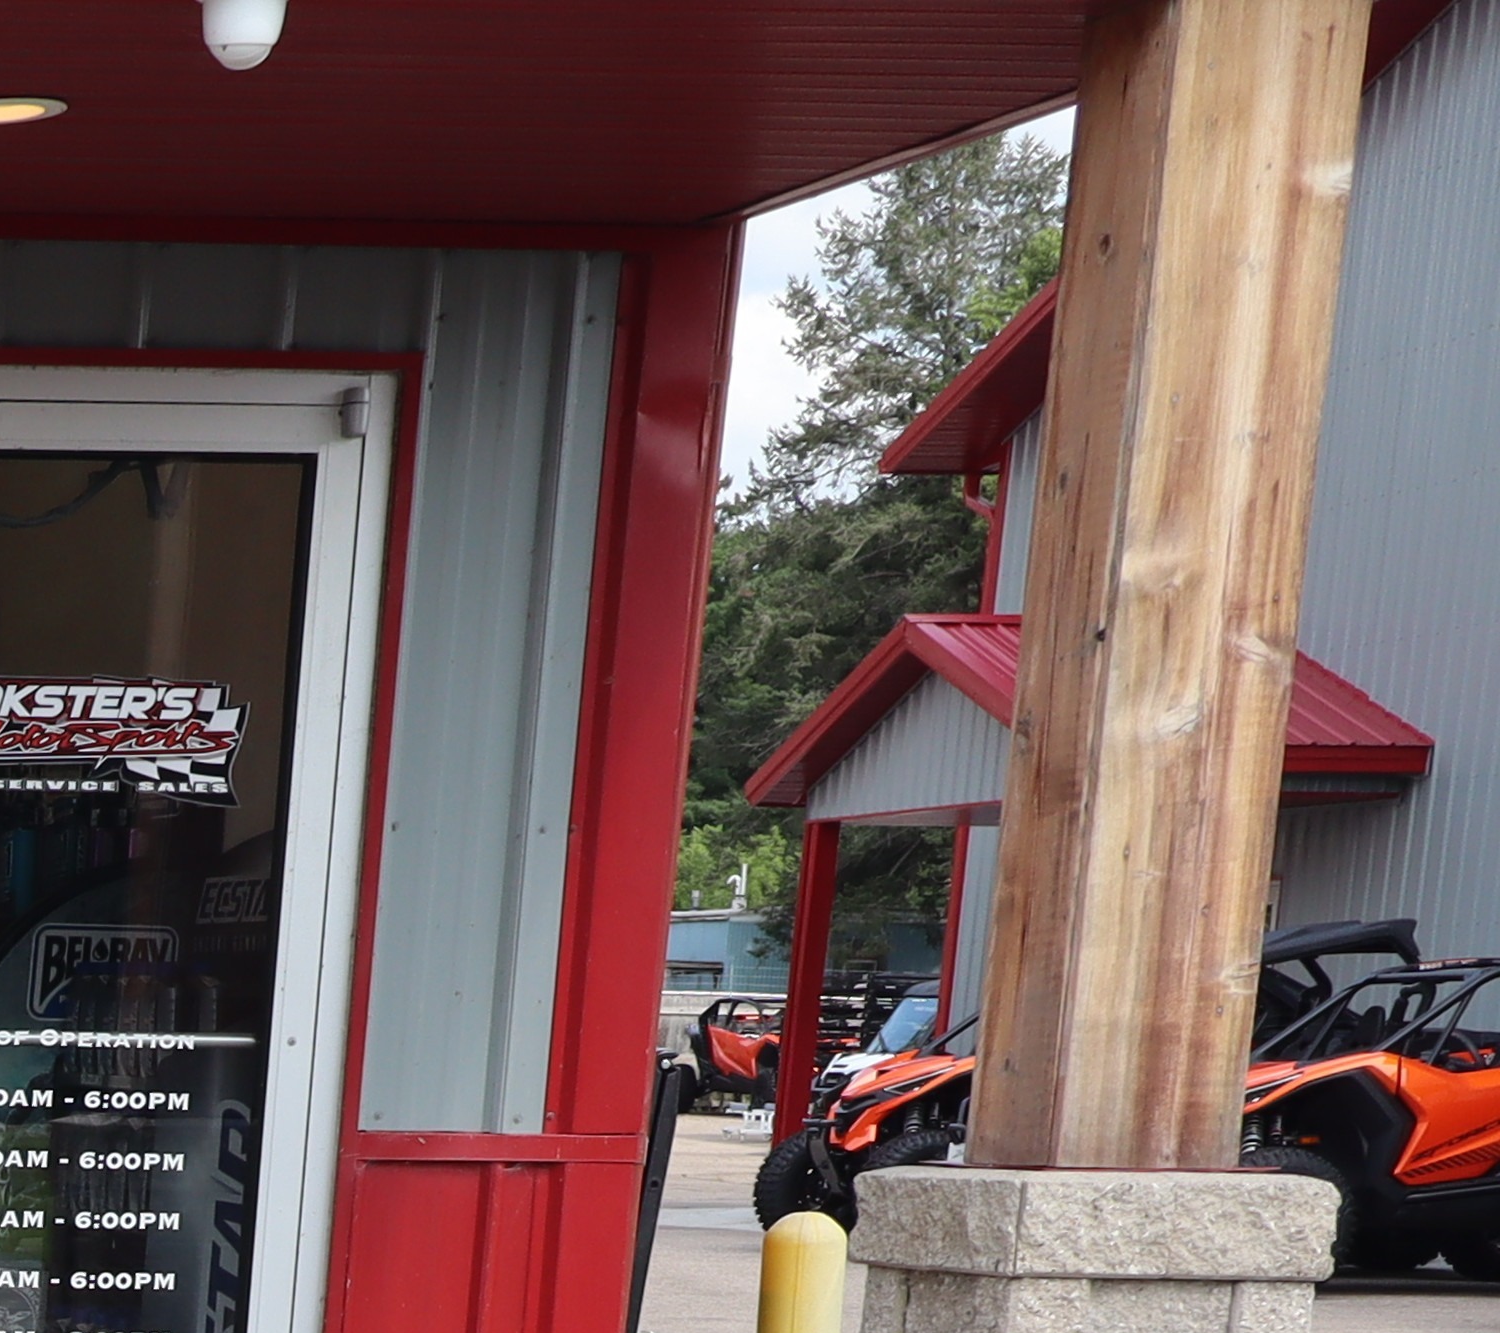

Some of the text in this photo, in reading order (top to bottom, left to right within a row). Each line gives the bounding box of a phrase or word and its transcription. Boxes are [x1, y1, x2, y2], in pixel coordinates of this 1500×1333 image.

[137, 781, 230, 794] SALES
[84, 1091, 190, 1111] 6:00PM
[78, 1152, 185, 1172] 6:00PM
[74, 1211, 180, 1231] 6:00PM
[70, 1271, 176, 1291] 6:00PM
